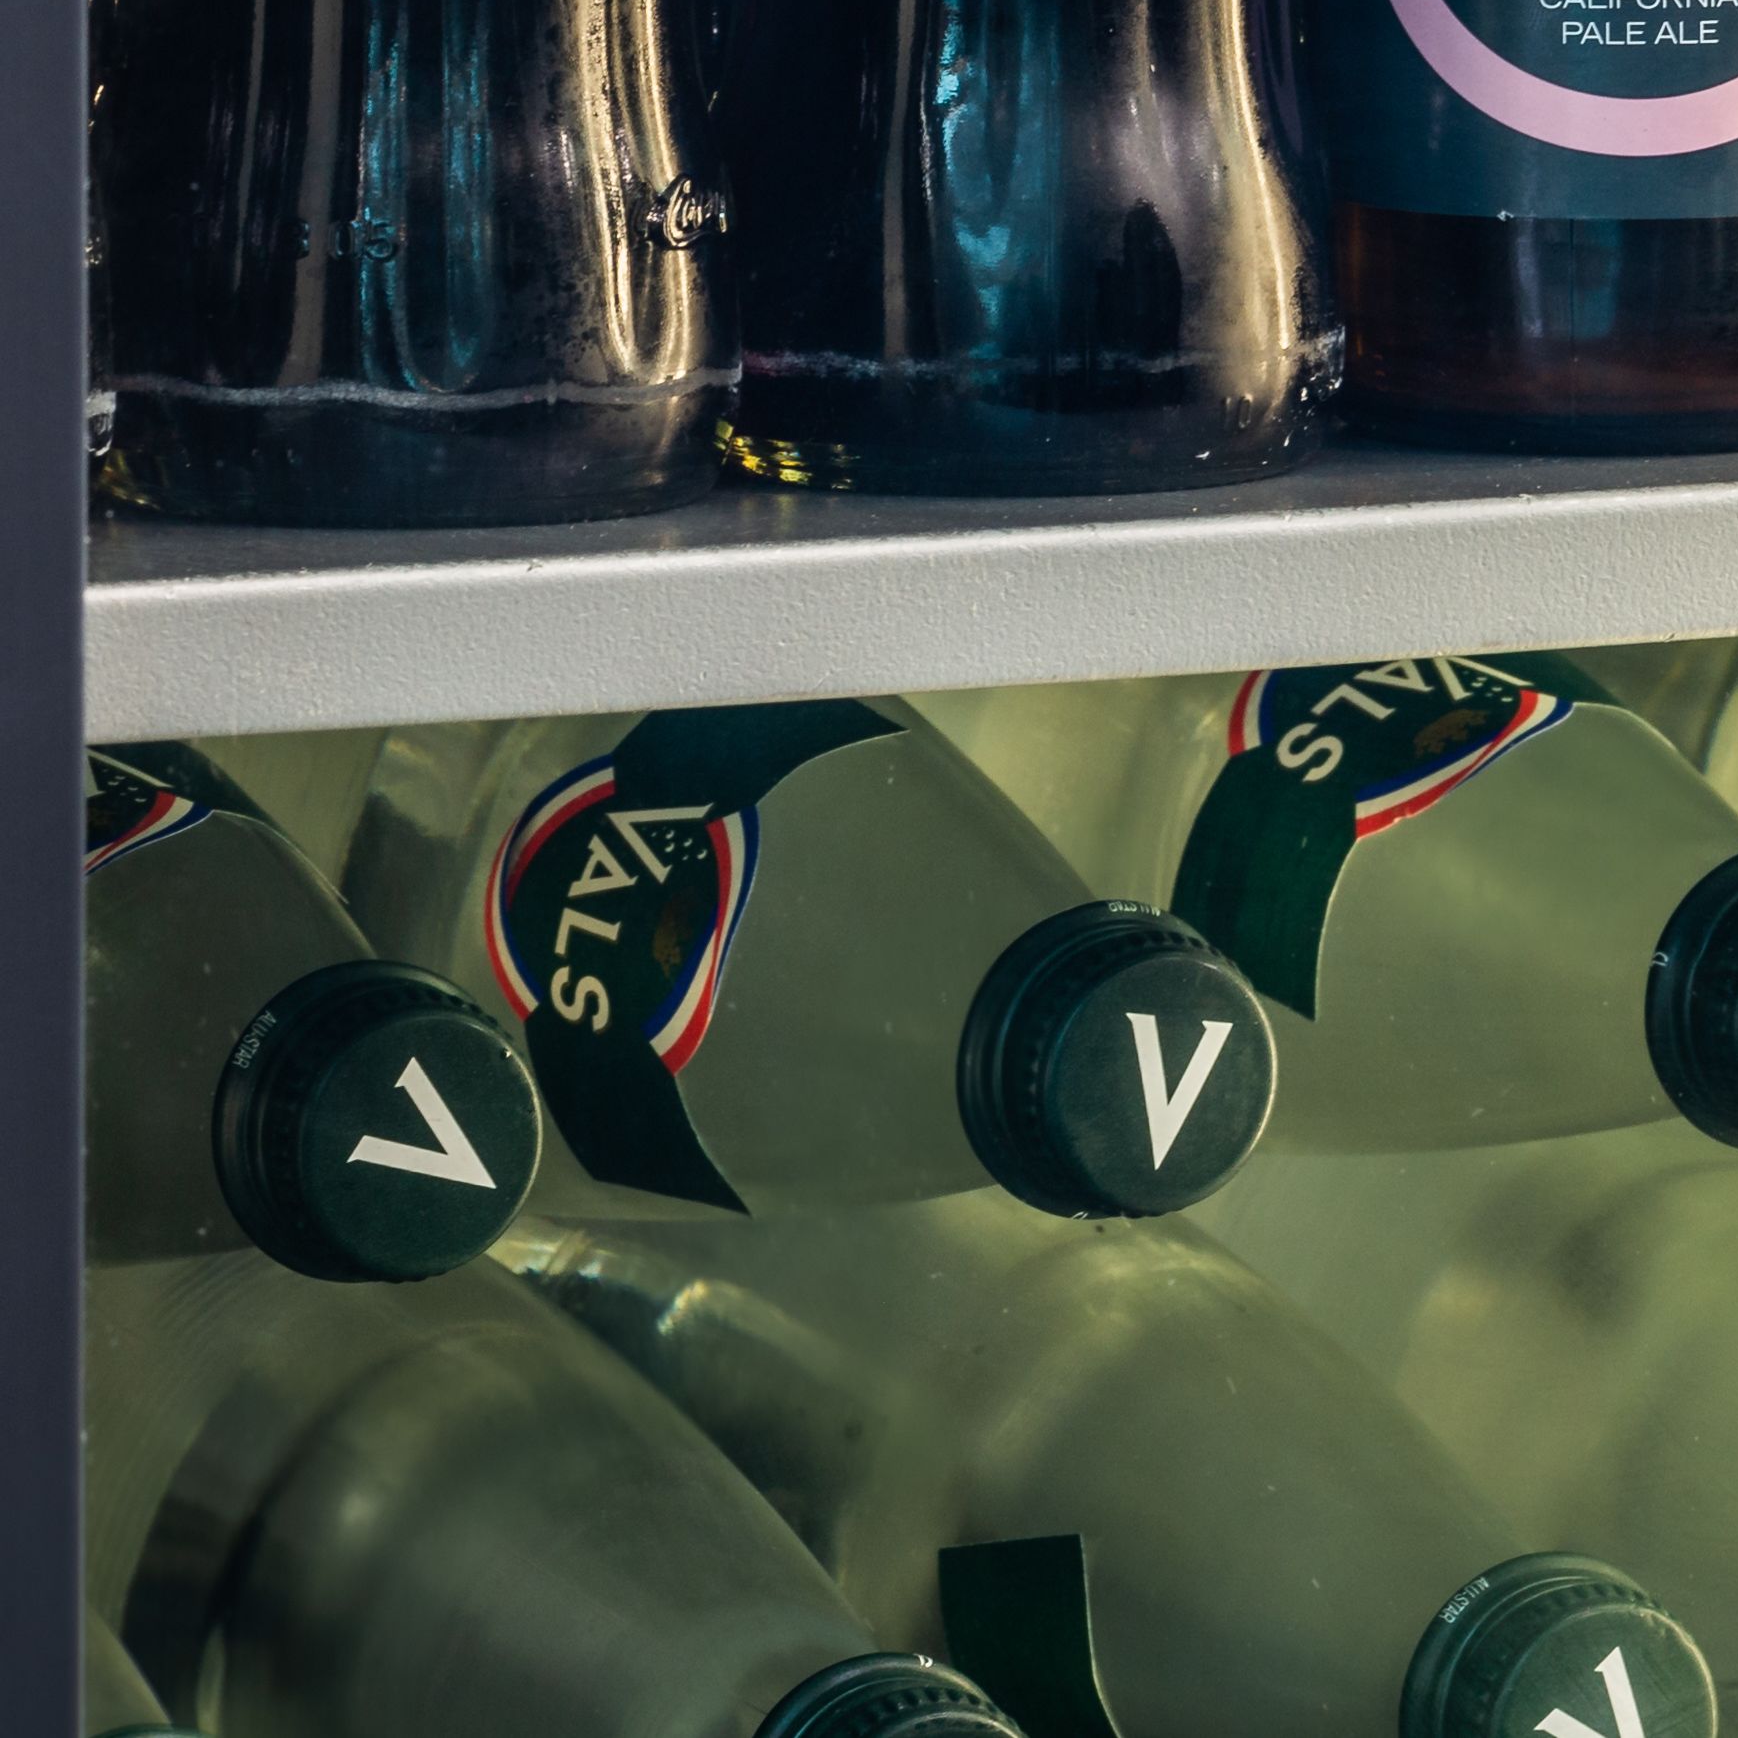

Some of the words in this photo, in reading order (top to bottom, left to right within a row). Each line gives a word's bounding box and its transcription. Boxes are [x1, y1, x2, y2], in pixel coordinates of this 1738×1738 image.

[1562, 21, 1646, 46] PALE
[1654, 20, 1719, 45] ALE
[550, 802, 714, 1033] VALS
[346, 1056, 498, 1190] V
[1126, 1012, 1233, 1170] V
